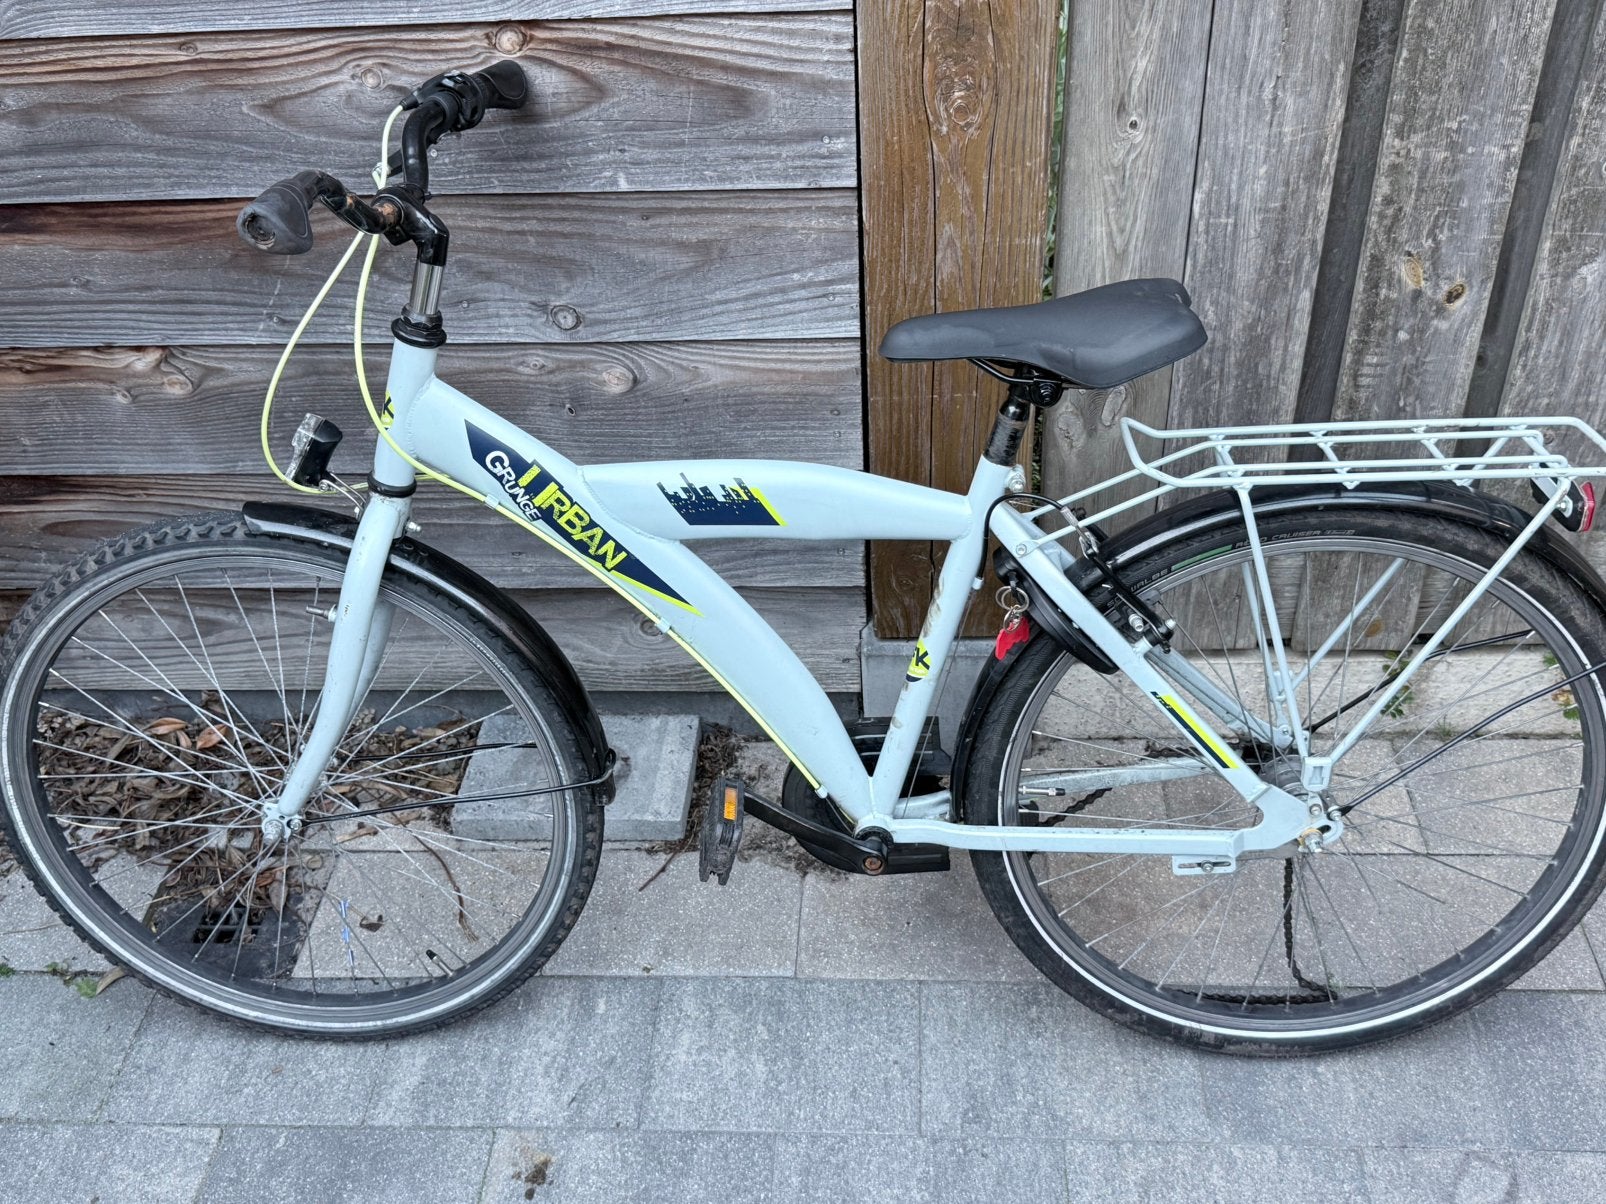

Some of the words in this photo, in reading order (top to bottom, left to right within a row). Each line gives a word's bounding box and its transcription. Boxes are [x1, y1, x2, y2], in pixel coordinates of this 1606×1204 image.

[485, 451, 541, 520] GRUNGE
[518, 465, 628, 570] URBAN
[1235, 536, 1268, 549] ROD
[1272, 530, 1321, 541] CRUISER
